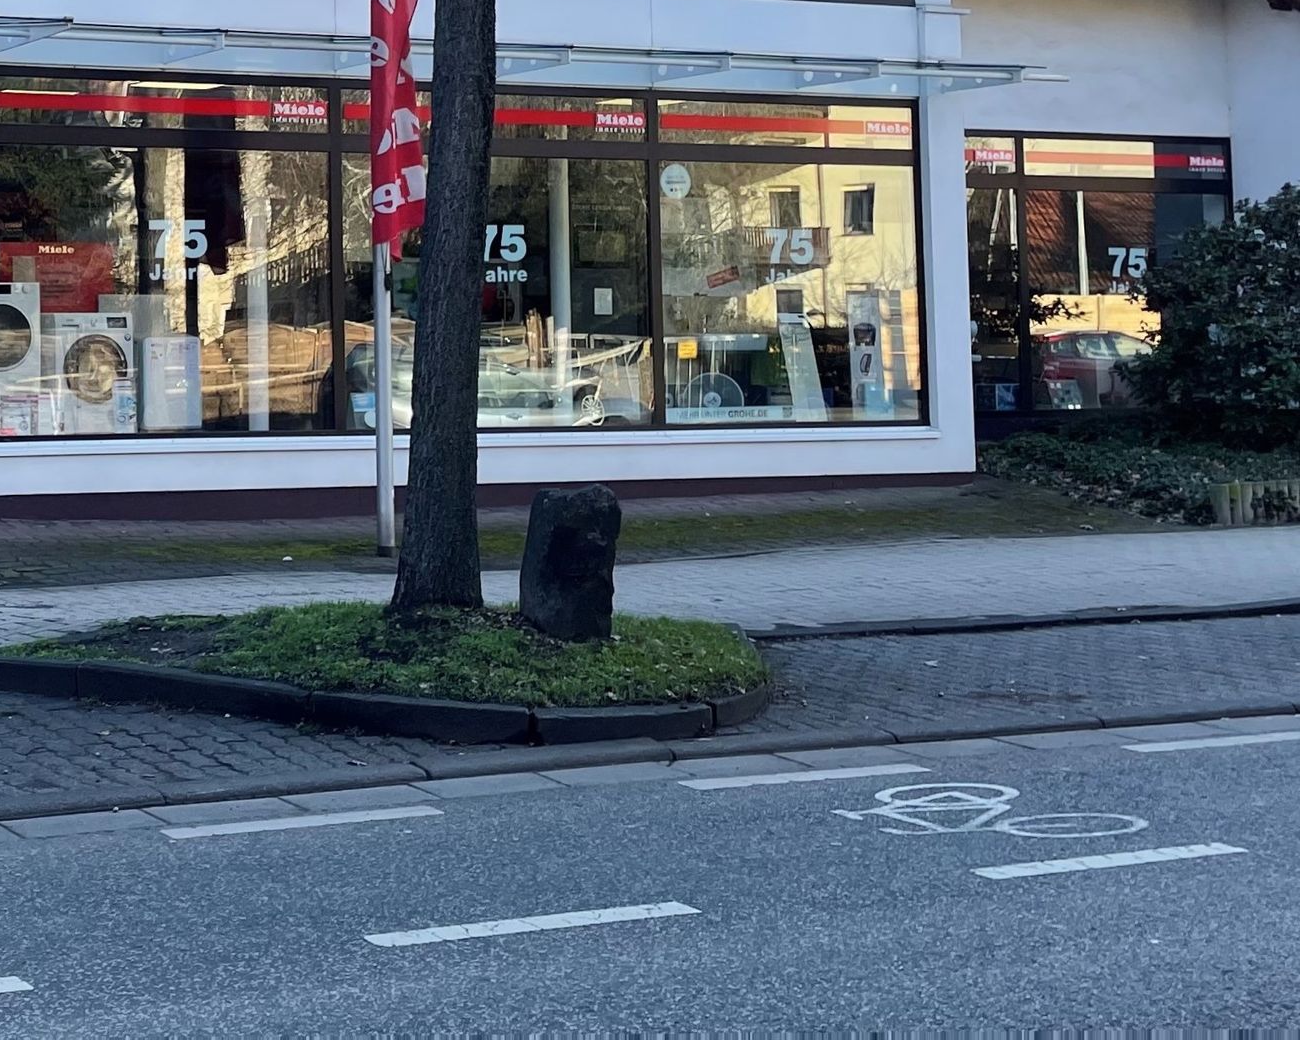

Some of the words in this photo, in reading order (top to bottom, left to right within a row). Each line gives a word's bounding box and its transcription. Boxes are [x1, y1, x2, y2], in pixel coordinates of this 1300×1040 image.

[273, 103, 325, 116] Miele
[596, 113, 644, 126] Miele
[867, 122, 909, 134] Miele
[975, 150, 1013, 160] Miele
[1190, 156, 1224, 166] Miele
[148, 219, 208, 259] 75
[483, 224, 527, 262] 75
[38, 245, 75, 254] Miele
[764, 228, 814, 265] 75
[1108, 247, 1147, 278] 75
[485, 266, 528, 282] ahre
